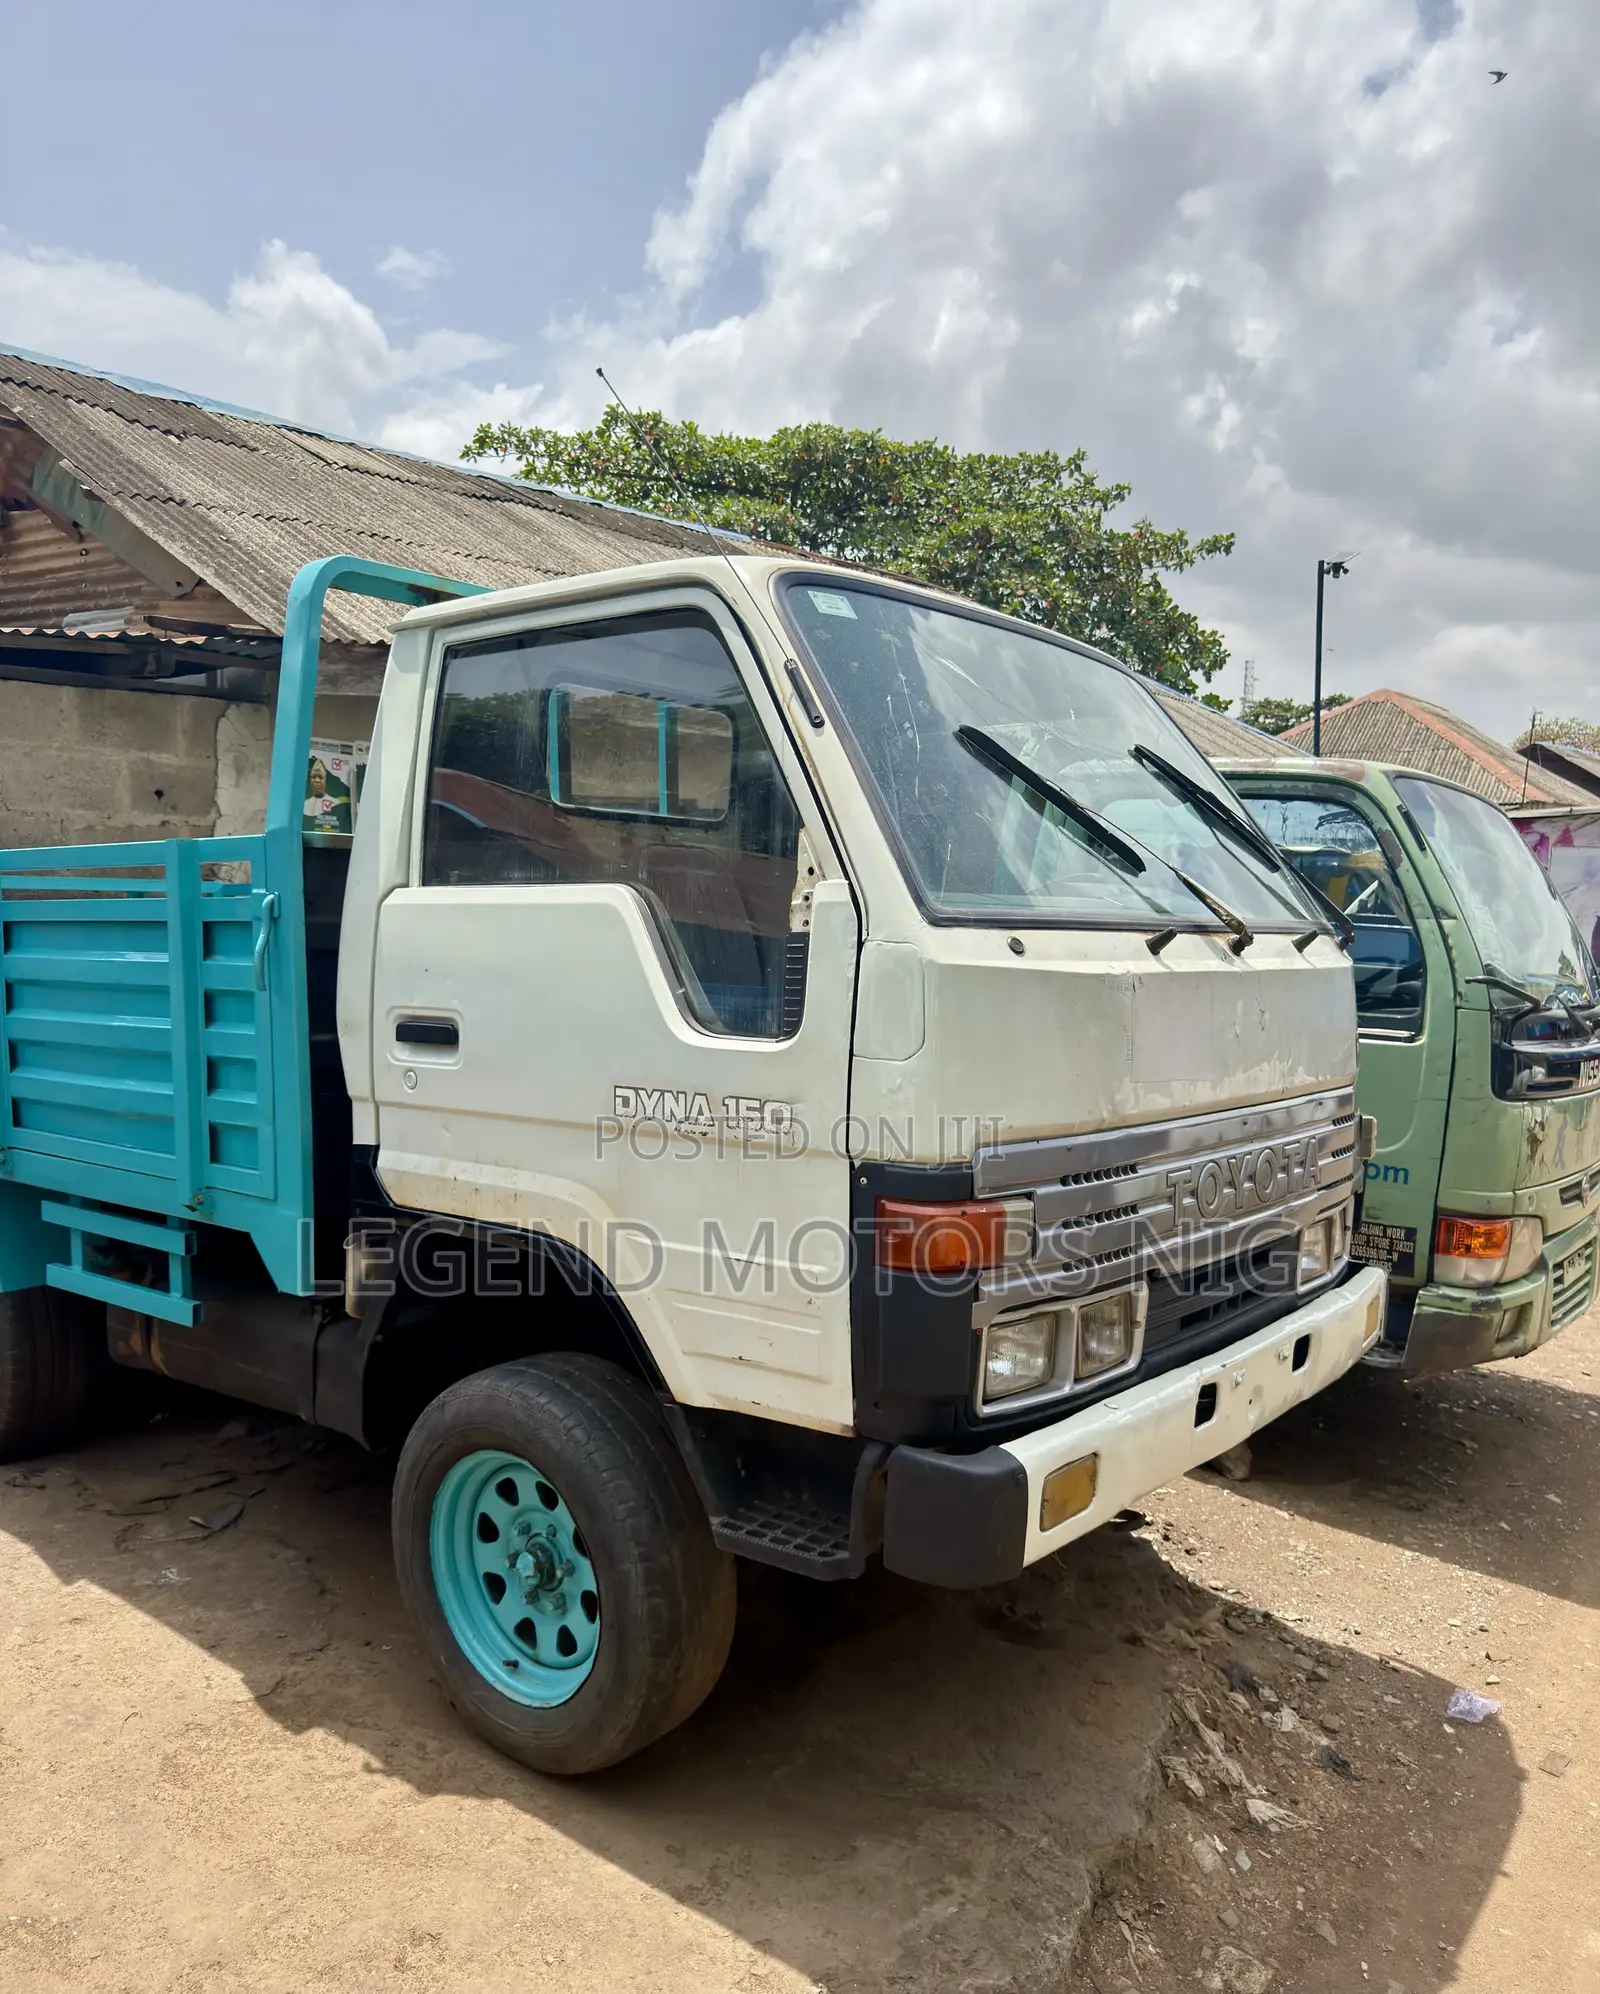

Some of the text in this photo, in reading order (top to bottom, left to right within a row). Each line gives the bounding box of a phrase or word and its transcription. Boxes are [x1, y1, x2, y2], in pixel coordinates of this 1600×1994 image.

[613, 1085, 793, 1135] DYNA 150
[1166, 1136, 1321, 1228] TOYOTA
[1386, 1227, 1406, 1240] WORK
